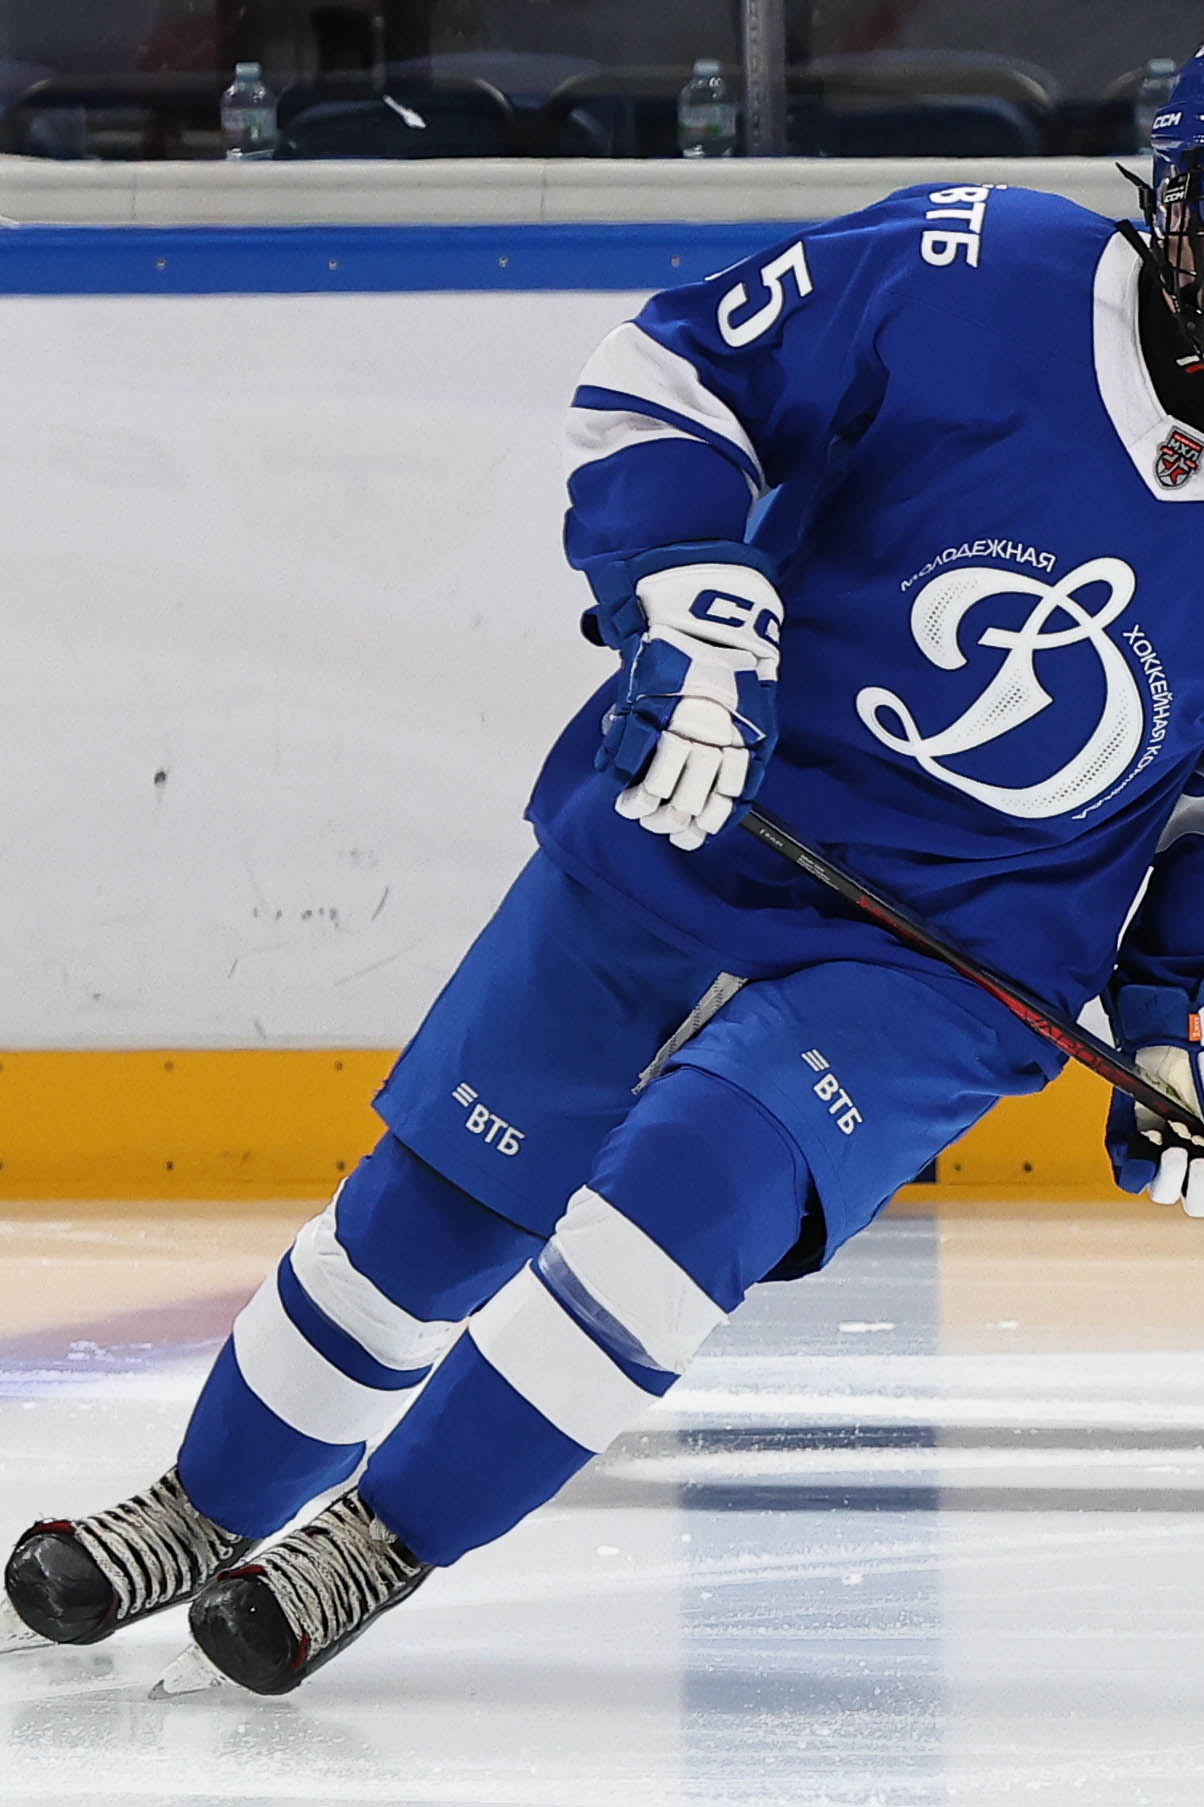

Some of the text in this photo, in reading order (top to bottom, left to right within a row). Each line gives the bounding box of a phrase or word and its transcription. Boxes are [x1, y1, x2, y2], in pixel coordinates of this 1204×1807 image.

[1152, 112, 1182, 129] CCM
[921, 186, 990, 268] ВТБ
[705, 241, 813, 347] 5
[1168, 439, 1199, 461] МХЛ
[900, 539, 1056, 592] МОЛОДЕЖНАЯ
[689, 589, 781, 645] CC
[1122, 624, 1173, 742] ХОККЕЙНАЯ
[465, 1103, 525, 1157] ВТБ
[813, 1073, 863, 1136] ВТБ
